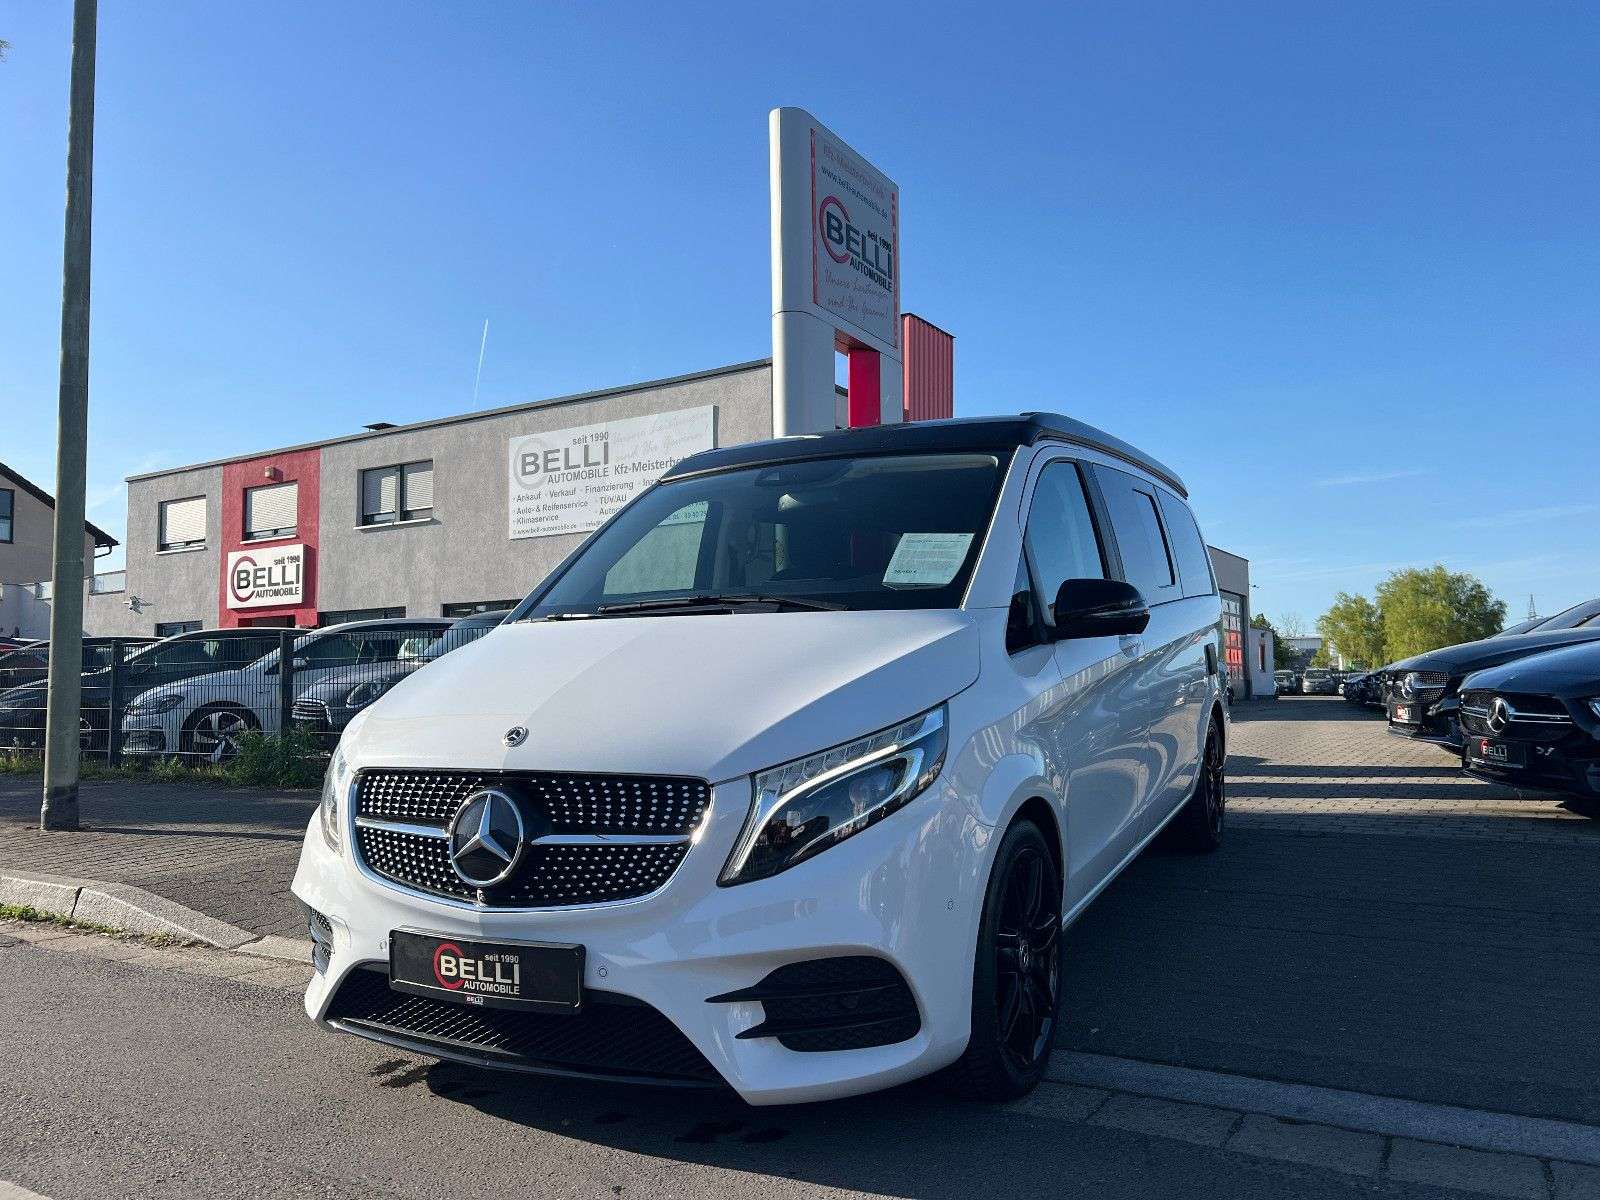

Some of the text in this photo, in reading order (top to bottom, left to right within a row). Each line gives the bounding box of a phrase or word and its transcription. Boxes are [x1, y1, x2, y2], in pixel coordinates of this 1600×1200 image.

[826, 211, 892, 280] BELLI
[849, 256, 892, 293] AUTOMOBILE
[572, 431, 609, 446] seit 1990
[521, 442, 609, 477] BELLI
[547, 467, 609, 485] AUTOMOBILE
[516, 491, 542, 502] Ankauf
[549, 487, 577, 498] Verkauf
[585, 480, 634, 494] Finanzierung
[542, 500, 589, 512] Reifenservice
[516, 514, 559, 525] Klimaservice
[286, 554, 300, 564] 1990
[236, 563, 300, 590] BELLI
[255, 586, 299, 599] AUTOMOBILE
[485, 954, 519, 964] seit 1990
[440, 955, 520, 984] BELLI
[463, 980, 520, 995] AUTOMOBILE
